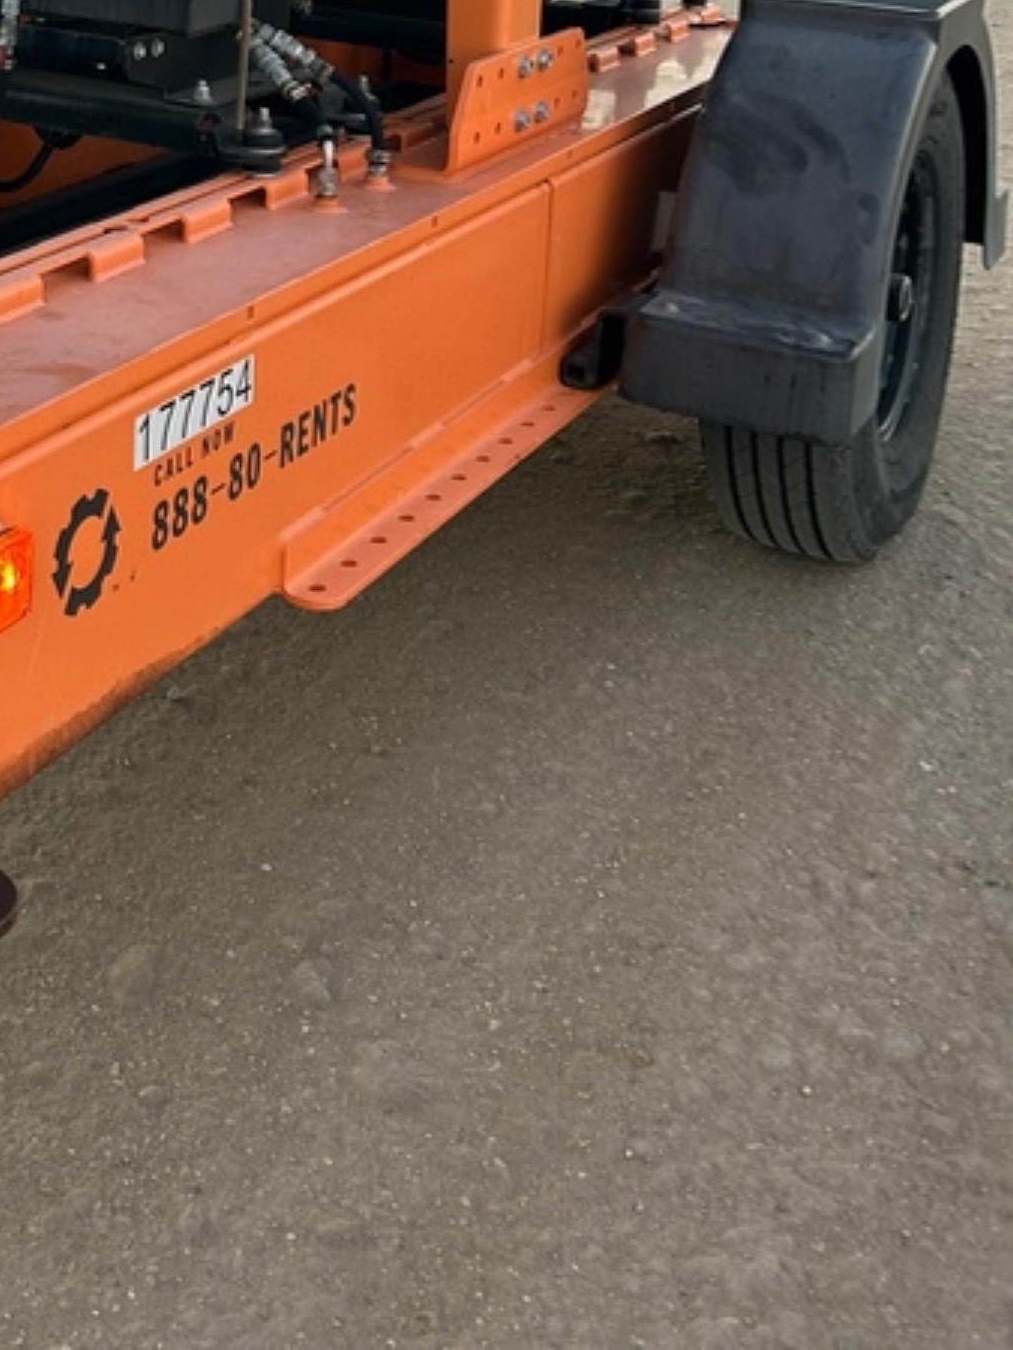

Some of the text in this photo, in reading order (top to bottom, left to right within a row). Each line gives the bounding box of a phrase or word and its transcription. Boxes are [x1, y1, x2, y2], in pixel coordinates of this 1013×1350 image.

[138, 360, 253, 461] 177754
[153, 421, 236, 487] CALL NOW
[151, 382, 357, 552] 888-80-RENTS
